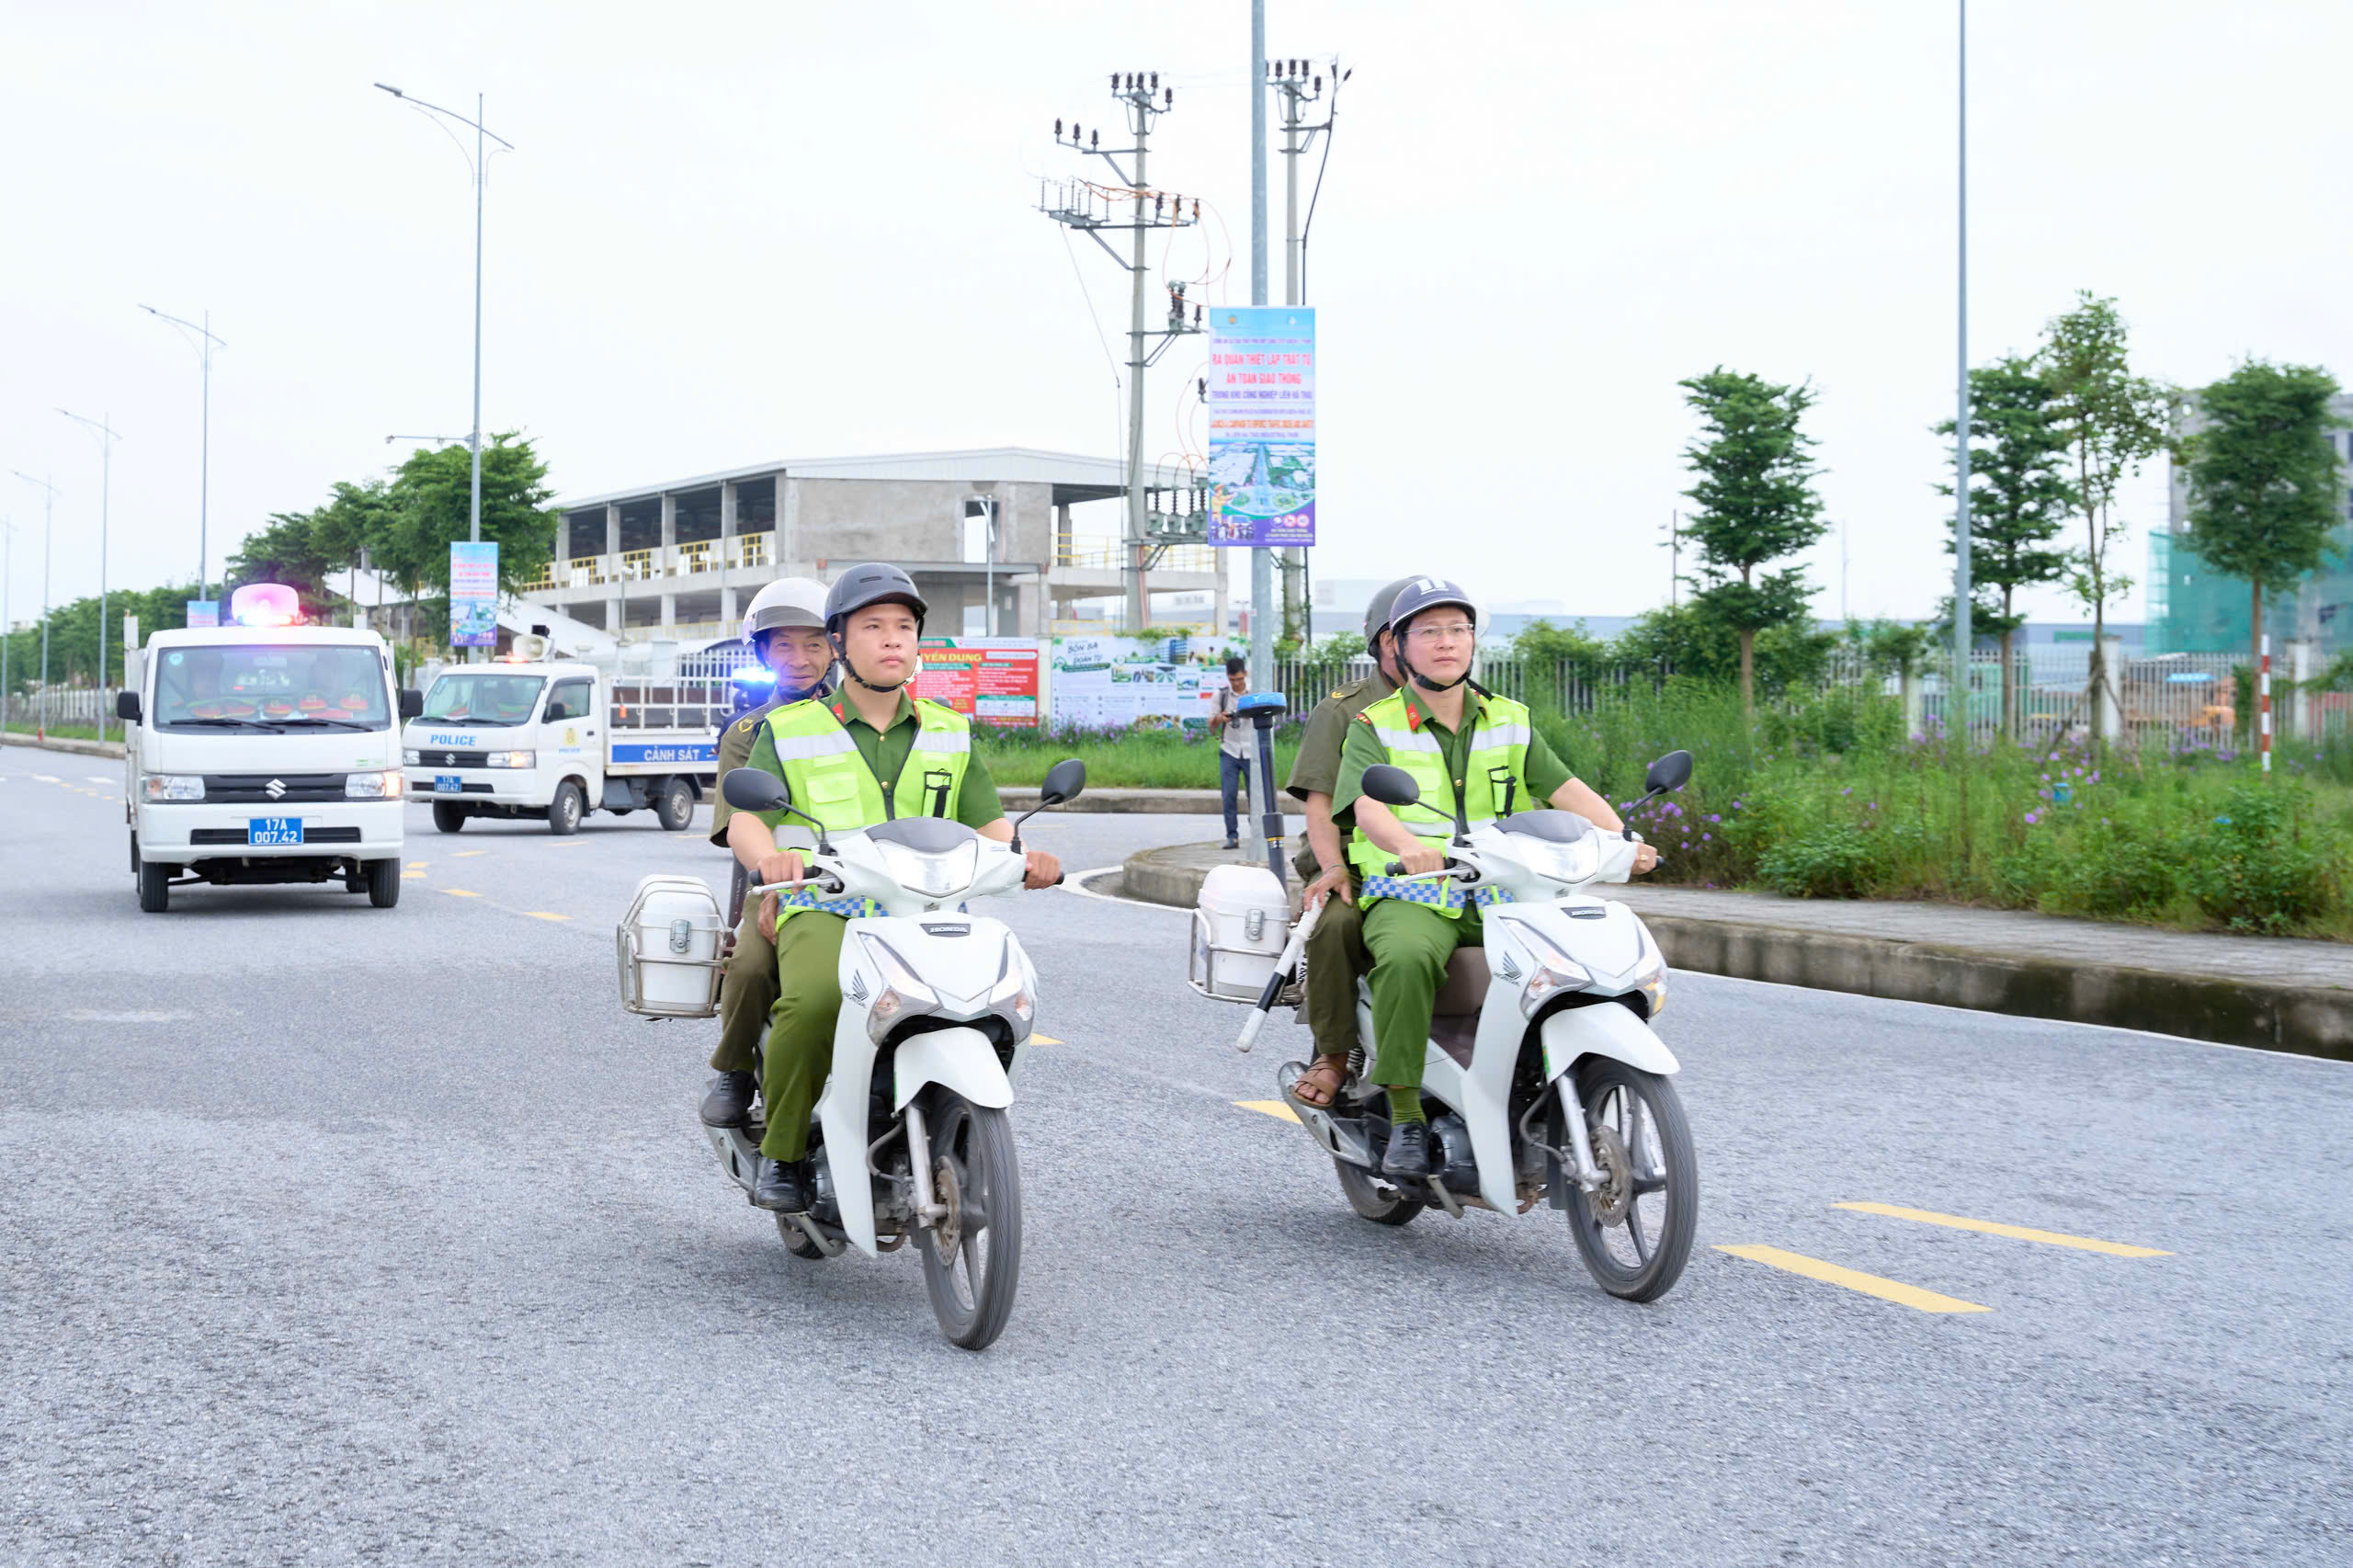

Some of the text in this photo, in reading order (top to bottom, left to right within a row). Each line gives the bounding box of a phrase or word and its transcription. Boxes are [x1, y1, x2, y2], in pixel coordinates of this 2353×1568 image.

[430, 734, 477, 746] POLICE
[643, 744, 699, 761] CẢNH SÁT
[266, 818, 288, 831] 17A
[255, 831, 298, 843] 007.42
